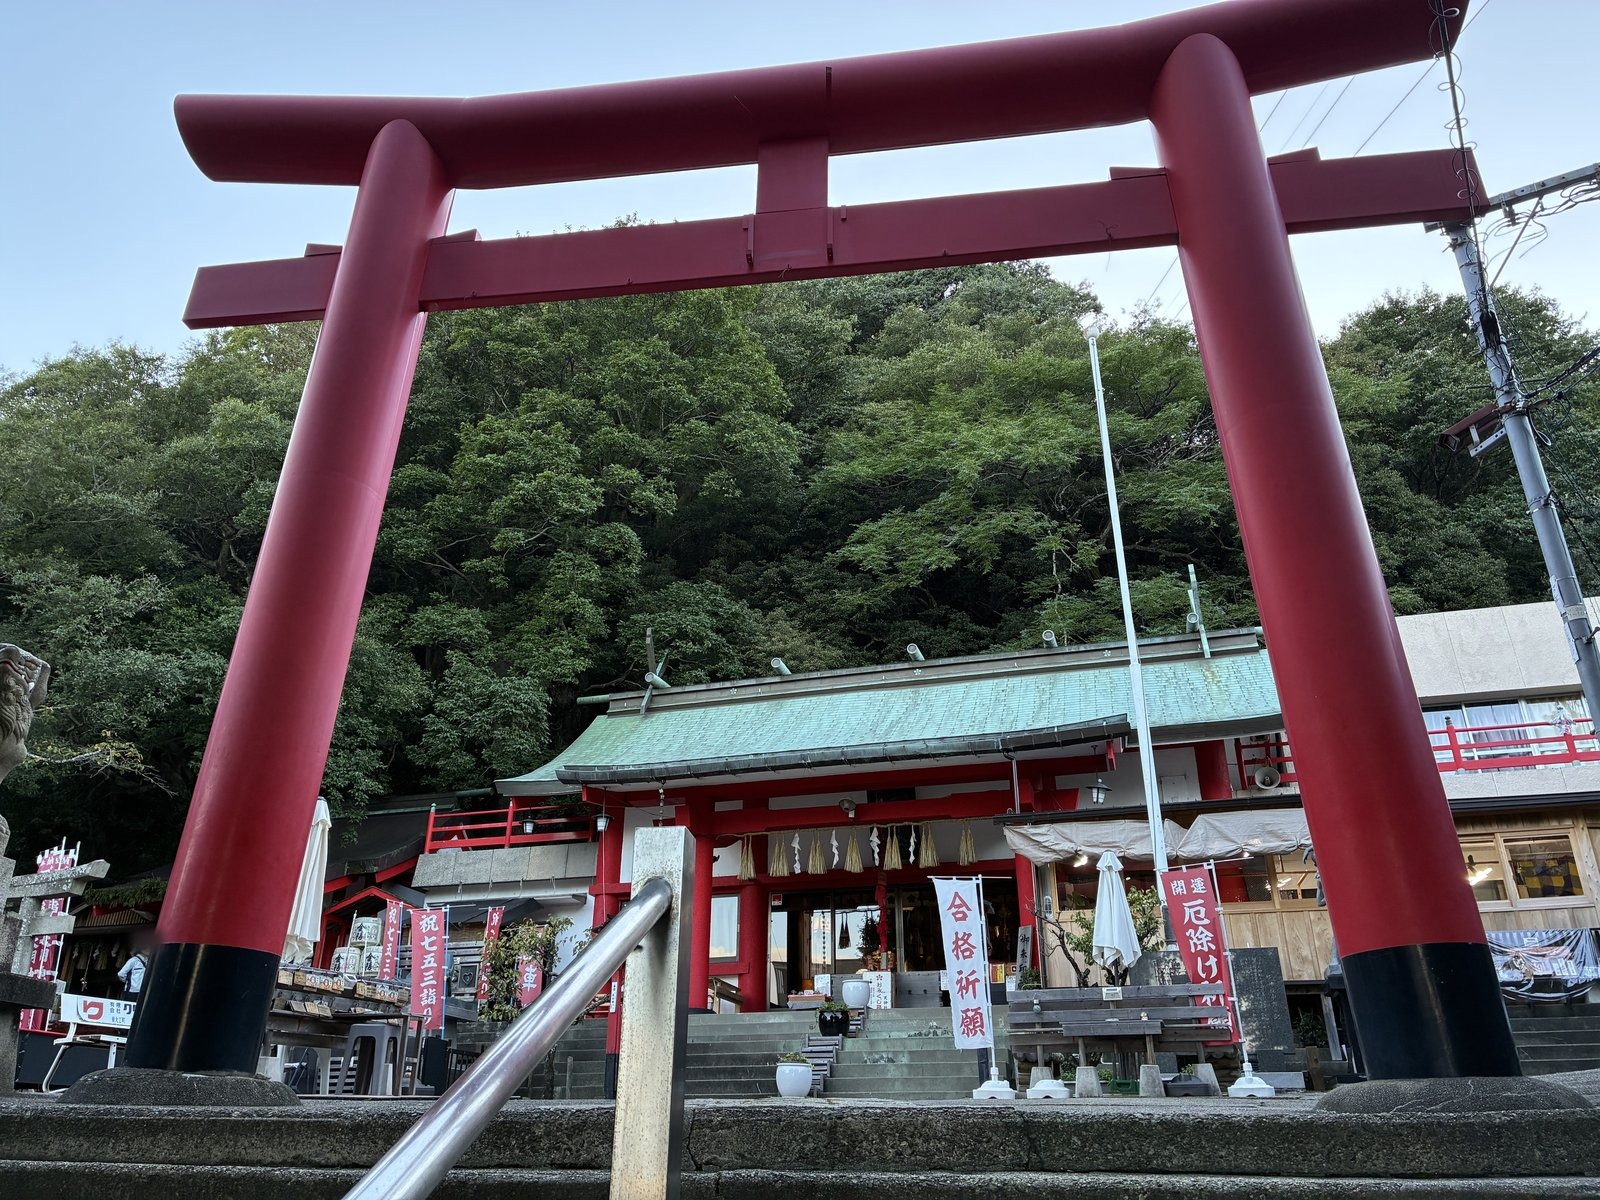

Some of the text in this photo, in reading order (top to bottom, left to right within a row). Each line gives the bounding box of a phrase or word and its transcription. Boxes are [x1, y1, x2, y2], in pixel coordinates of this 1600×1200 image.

[1170, 877, 1208, 895] 開運
[946, 891, 985, 1038] 合格祈願
